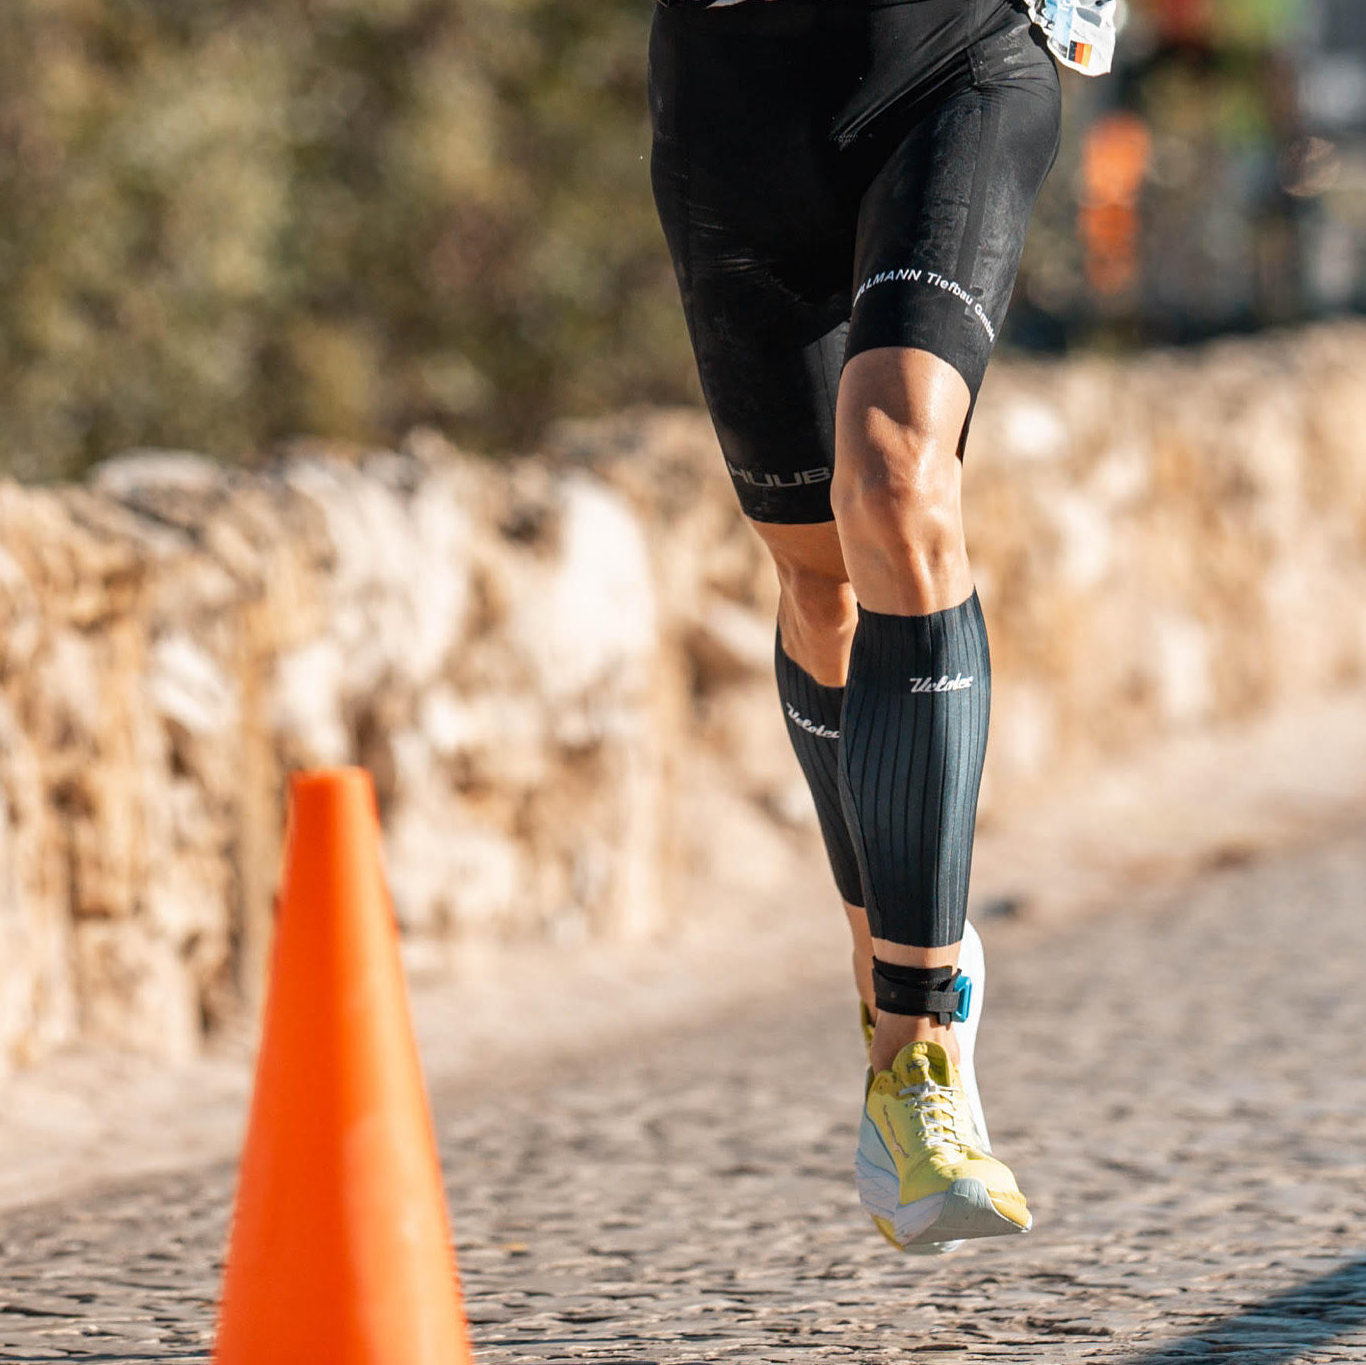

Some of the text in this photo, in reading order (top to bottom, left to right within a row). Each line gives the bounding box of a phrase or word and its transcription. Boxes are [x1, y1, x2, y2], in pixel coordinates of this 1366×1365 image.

[927, 271, 973, 305] Tiefbau
[974, 303, 995, 342] GmbH
[727, 460, 833, 488] HUUB
